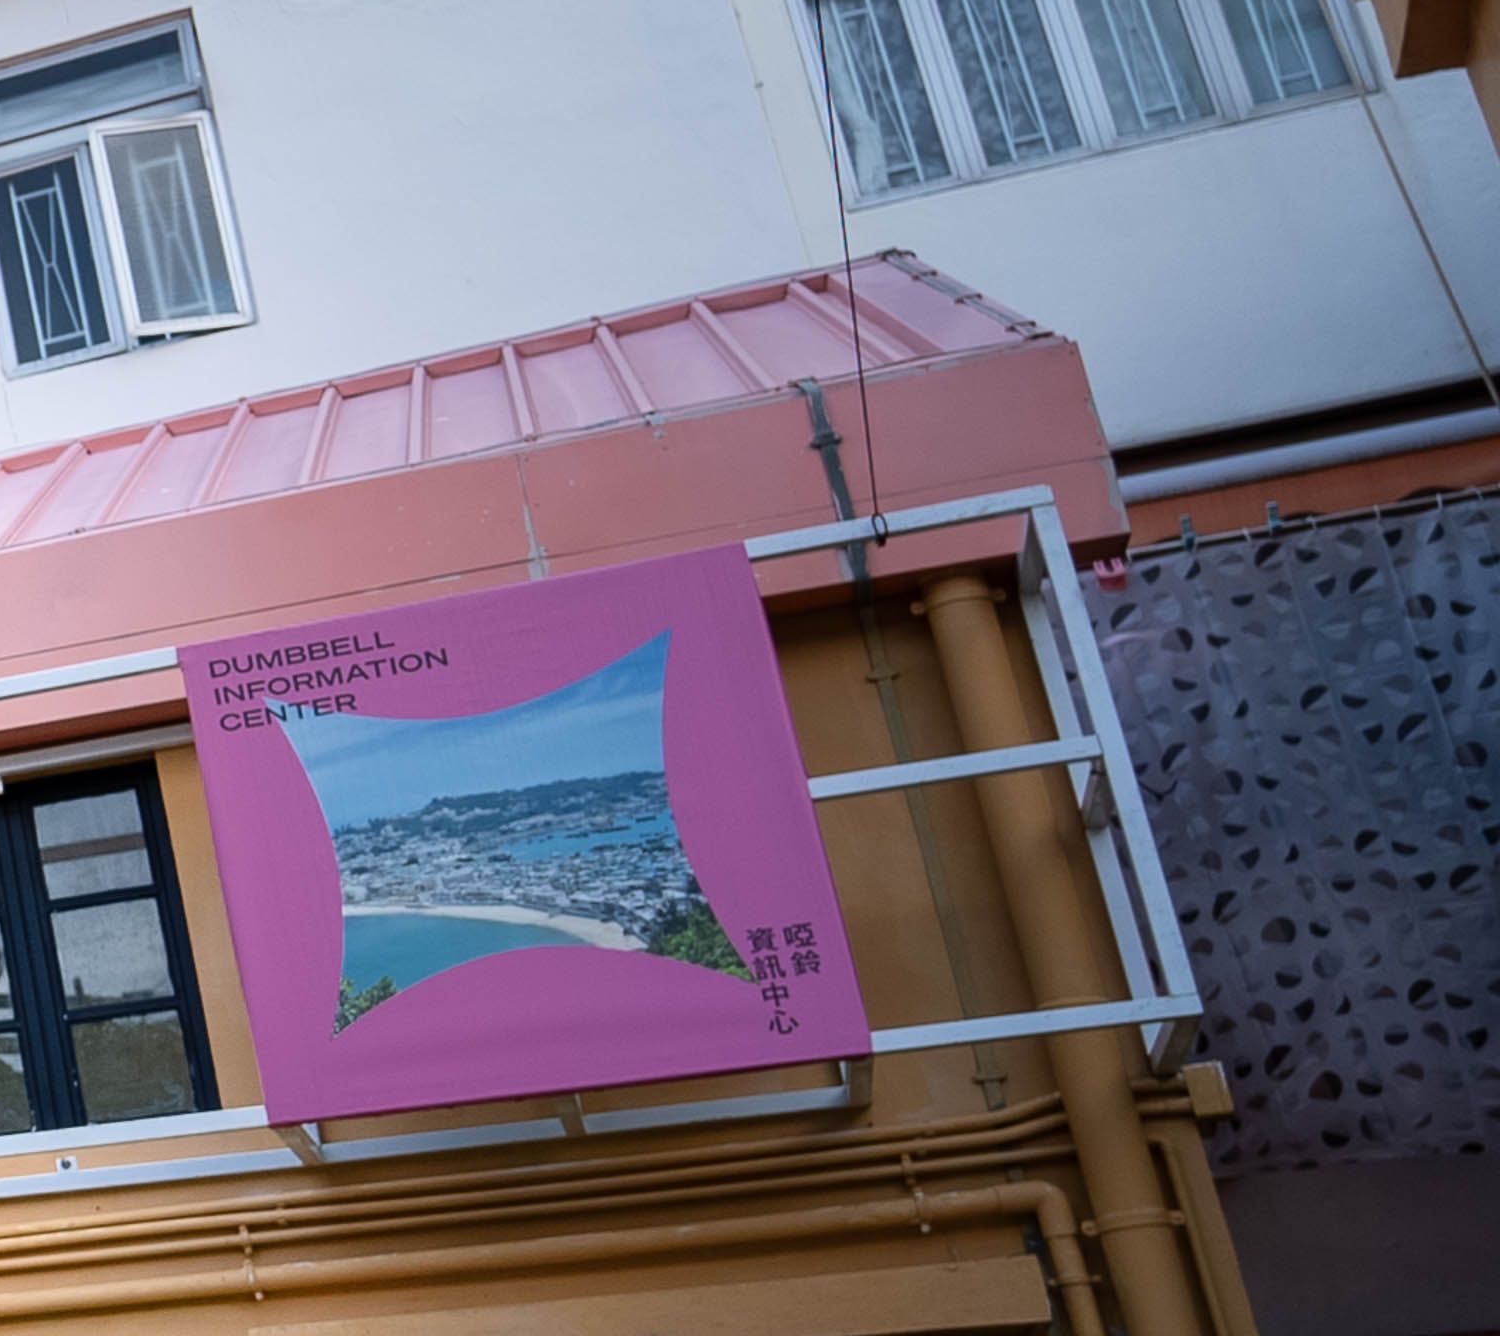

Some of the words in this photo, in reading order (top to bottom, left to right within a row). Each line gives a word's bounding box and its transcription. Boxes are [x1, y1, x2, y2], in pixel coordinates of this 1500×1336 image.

[209, 632, 395, 678] DUMBBELL
[214, 648, 449, 705] INFORMATION
[219, 694, 358, 732] CENTER
[783, 923, 820, 976] 啞鈴
[746, 928, 799, 1035] 資訊中心
